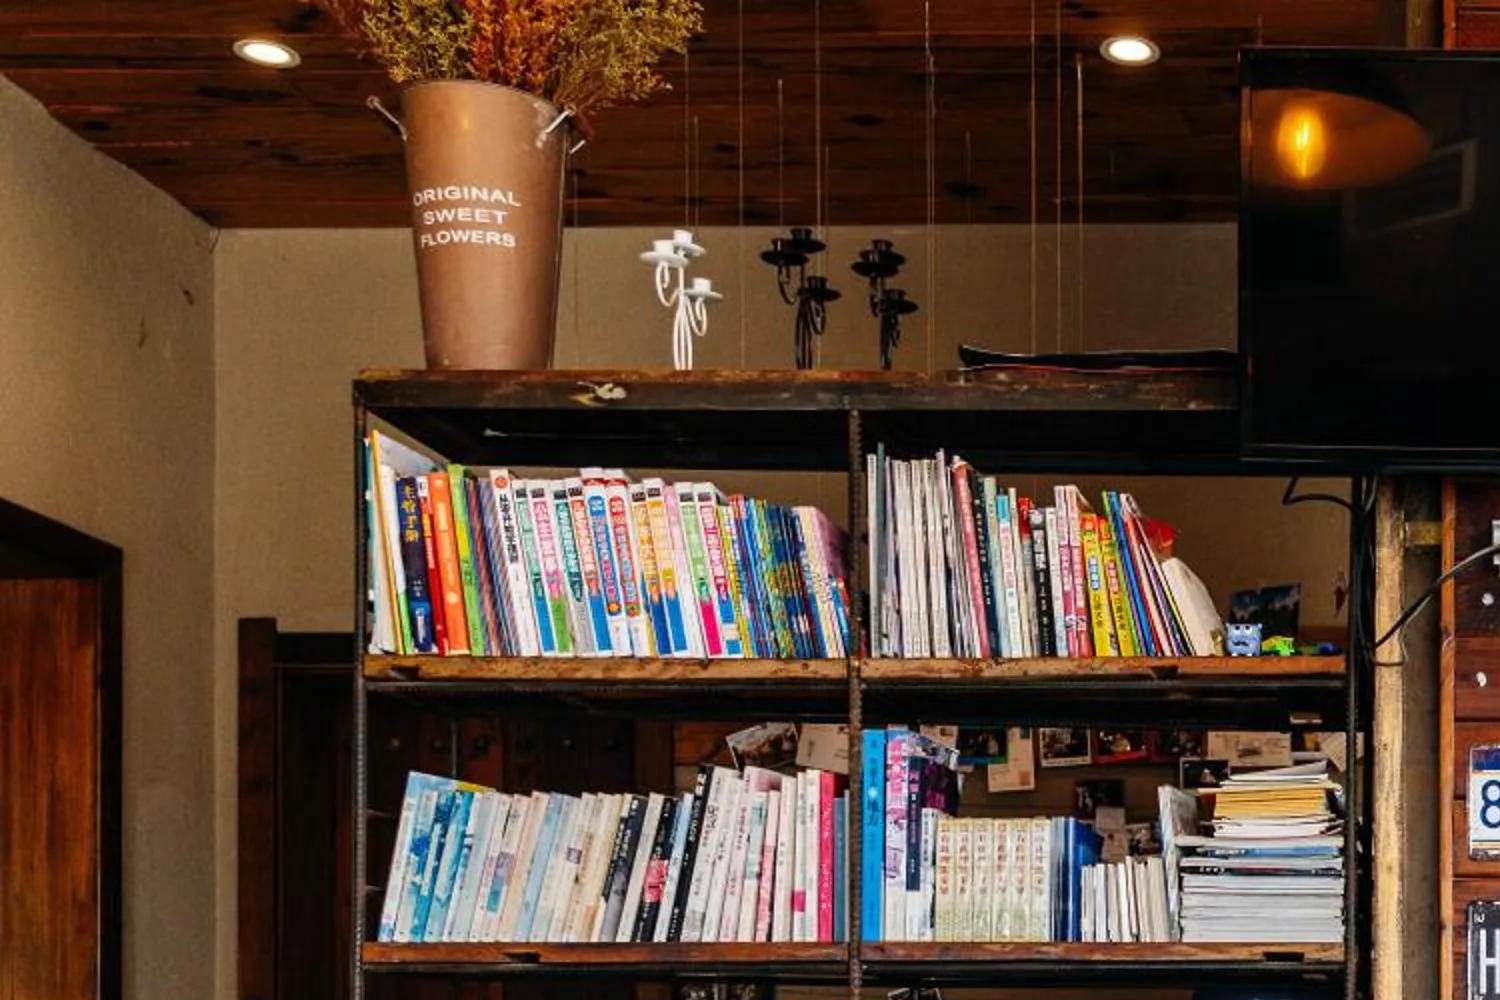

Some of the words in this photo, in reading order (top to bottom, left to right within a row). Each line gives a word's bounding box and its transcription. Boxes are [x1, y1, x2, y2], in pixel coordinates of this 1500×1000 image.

[412, 186, 521, 207] ORIGINAL
[422, 206, 508, 225] SWEET
[420, 228, 516, 248] FLOWERS
